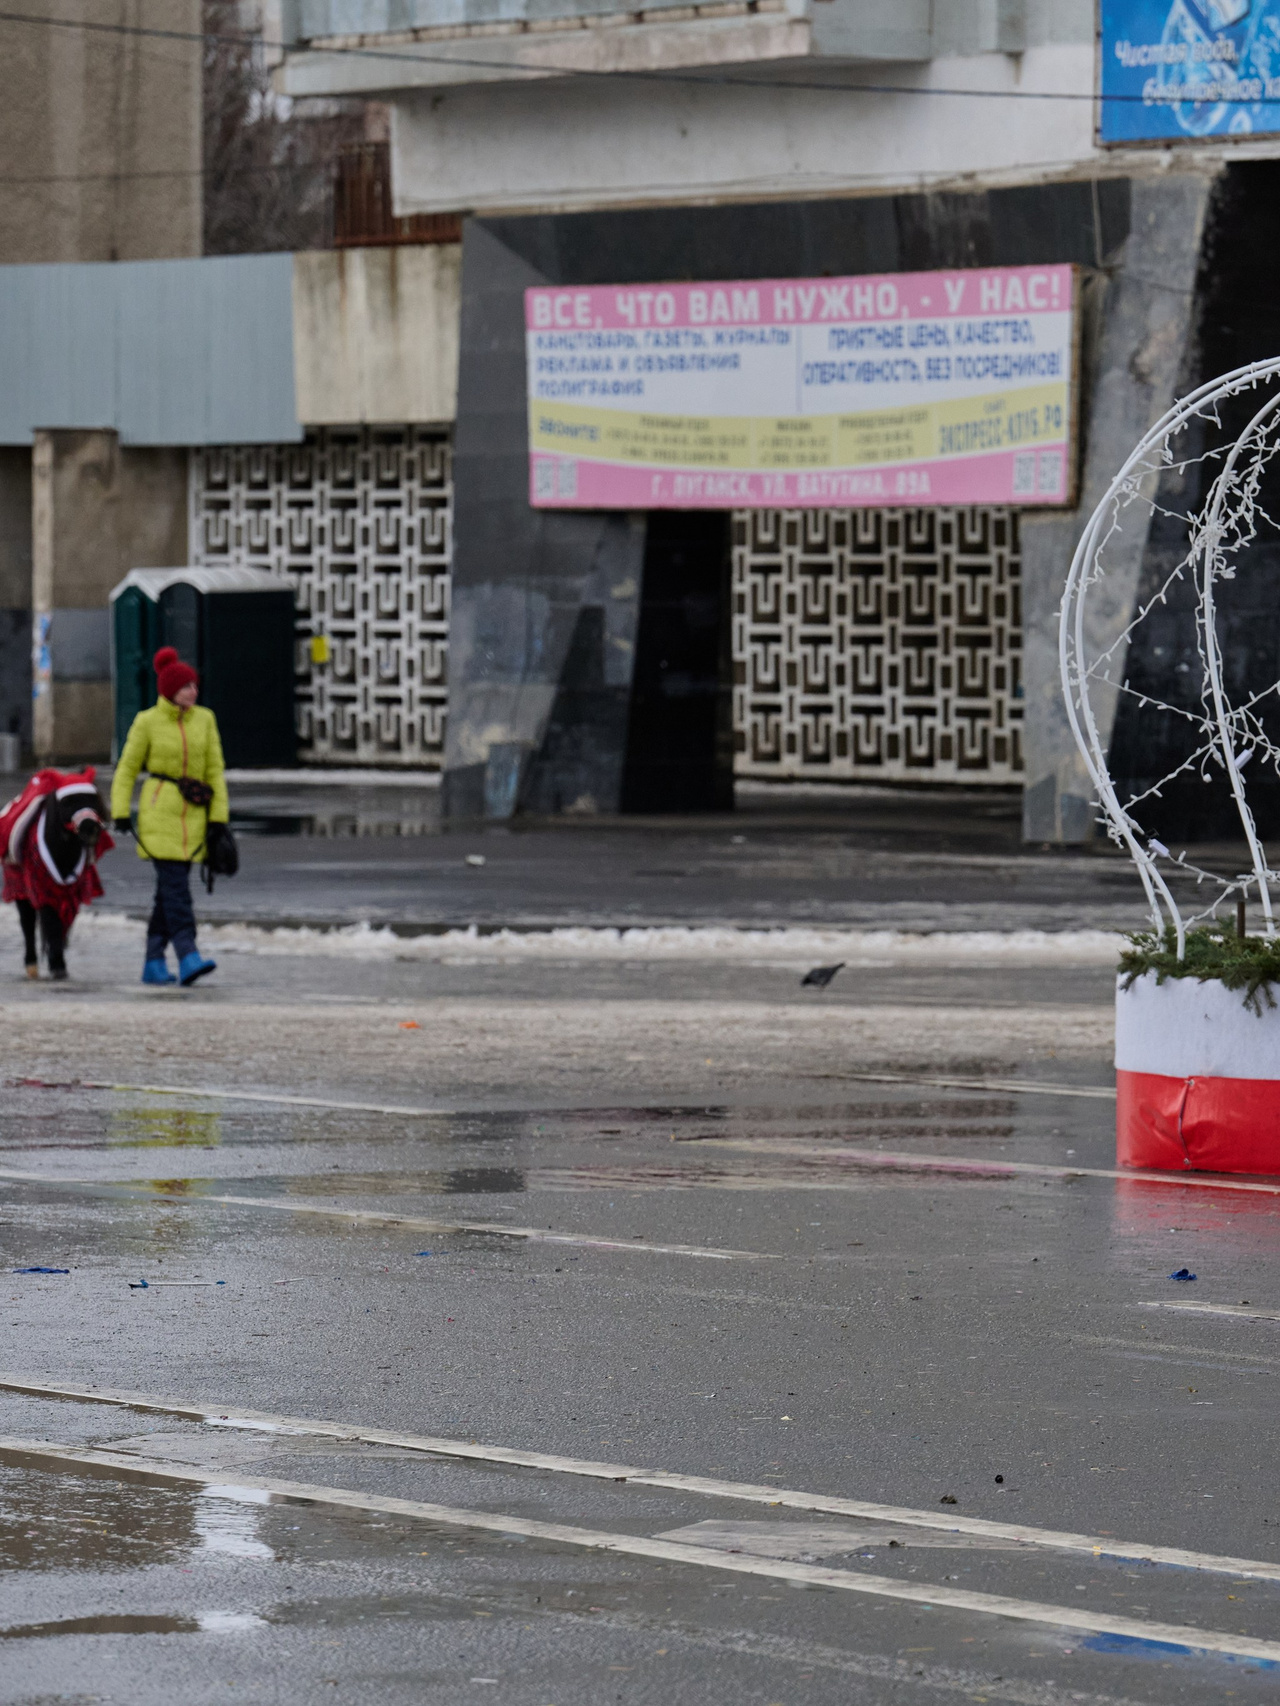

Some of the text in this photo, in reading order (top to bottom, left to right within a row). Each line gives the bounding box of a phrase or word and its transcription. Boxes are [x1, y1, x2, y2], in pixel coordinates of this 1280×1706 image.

[1115, 40, 1186, 67] Чистая
[533, 292, 602, 328] ВСЕ,
[616, 291, 675, 325] ЧТО
[689, 287, 759, 323] ВАМ
[774, 281, 909, 319] НУЖНО,
[944, 277, 966, 313] У
[980, 273, 1061, 311] НАС!
[714, 327, 790, 346] ЖУРНАЛЫ
[829, 324, 903, 350] ПРИЯТНЫЕ
[955, 318, 1035, 346] КАЧЕСТВО,
[536, 353, 741, 373] РЕКЛАМА И ОБЪЯВЛЕНИЯ
[926, 355, 950, 381] БЕЗ
[536, 379, 645, 397] ПОЛИГРАФИЯ
